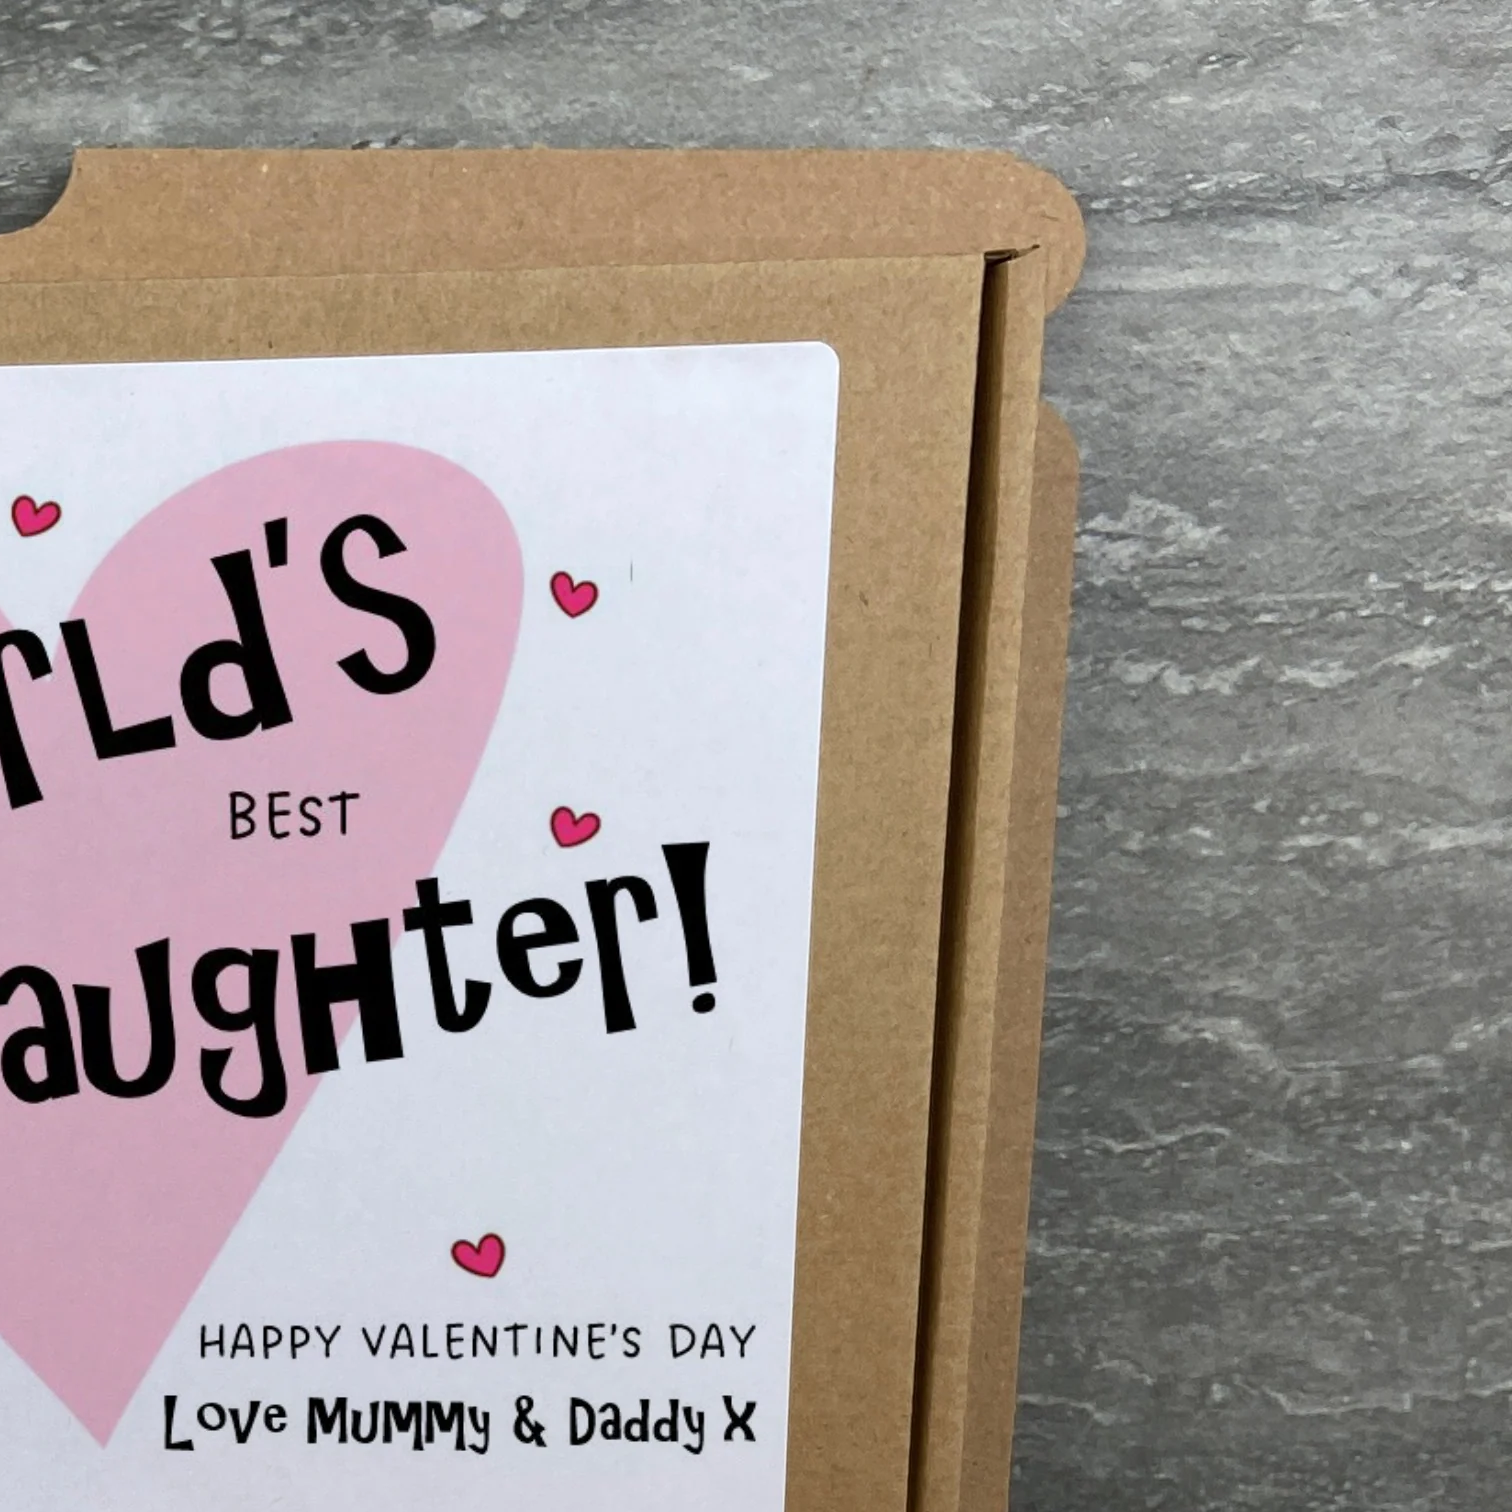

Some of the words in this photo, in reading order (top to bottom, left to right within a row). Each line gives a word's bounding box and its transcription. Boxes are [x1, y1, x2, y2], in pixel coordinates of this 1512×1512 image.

[229, 790, 360, 840] BEST
[200, 1323, 341, 1360] HAPPY
[361, 1323, 641, 1360] VALENTINE'S
[669, 1323, 756, 1359] DAY
[164, 1395, 287, 1452] Love
[513, 1395, 547, 1448] &
[569, 1396, 705, 1455] Daddy
[722, 1395, 757, 1442] X
